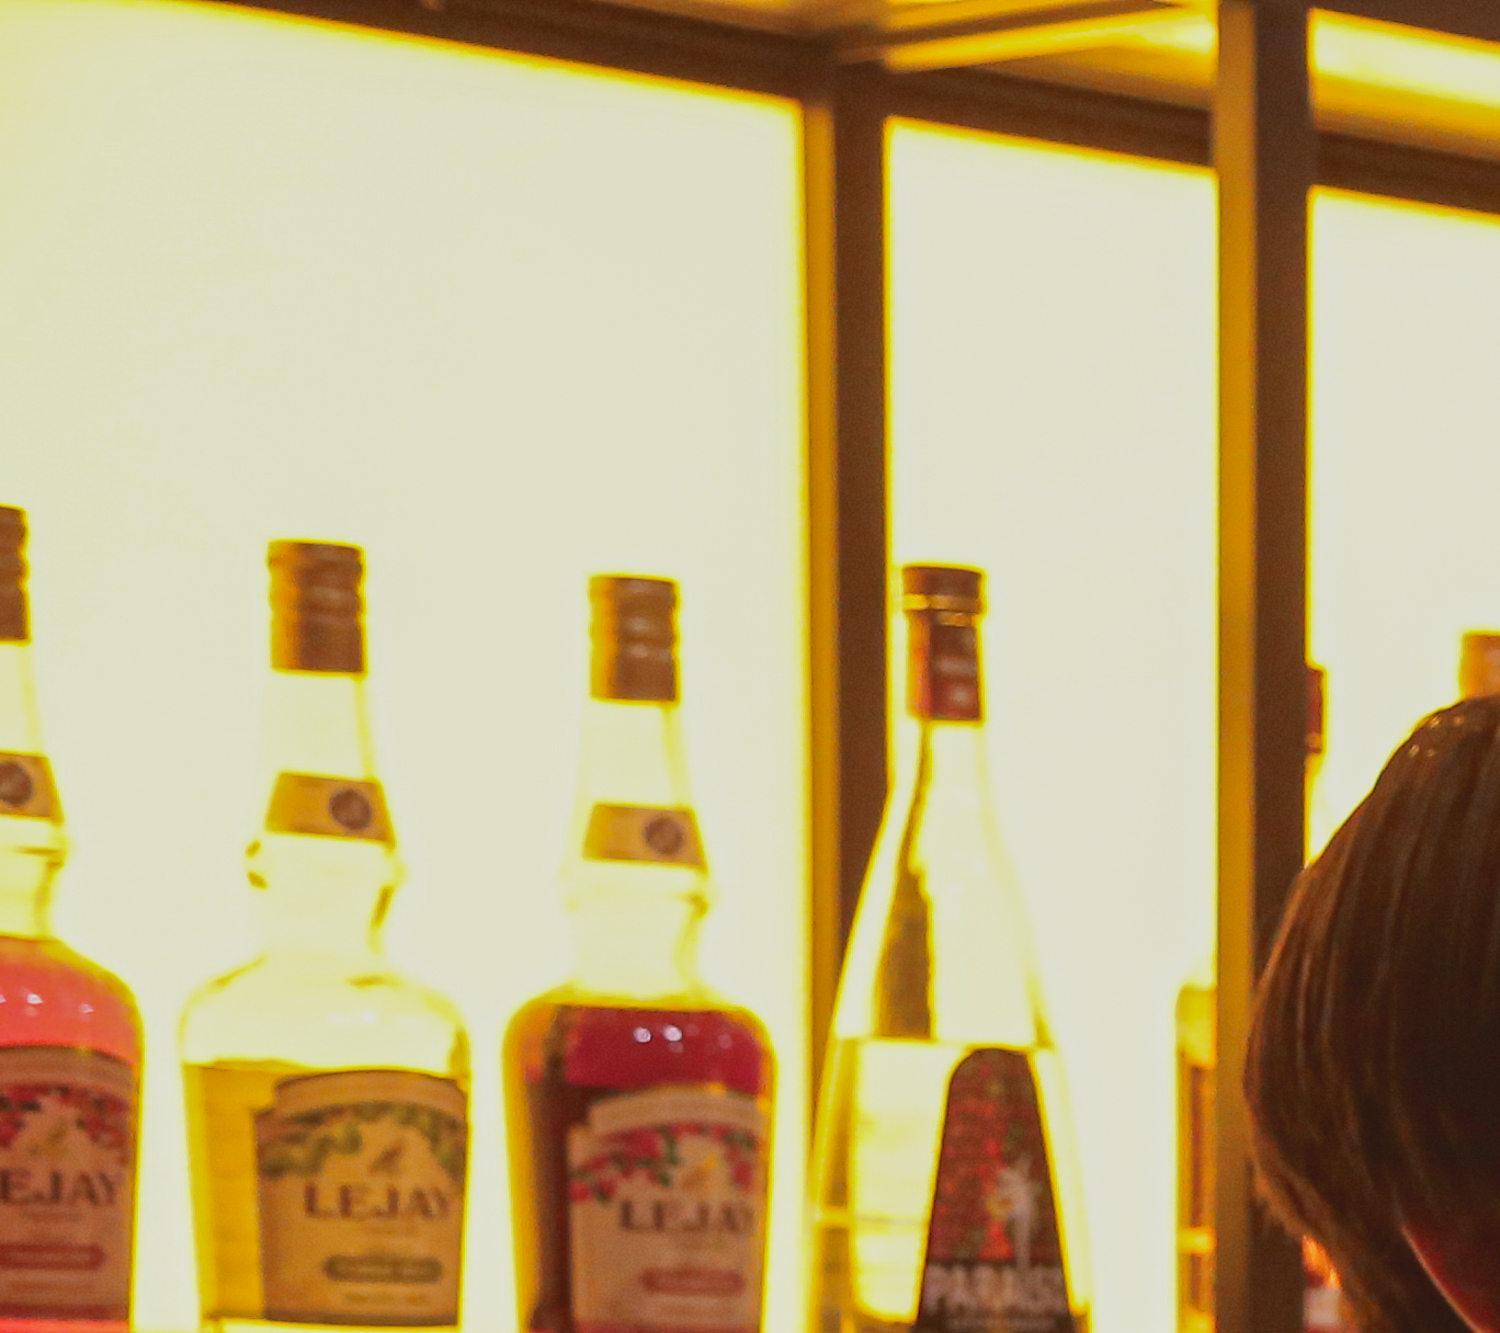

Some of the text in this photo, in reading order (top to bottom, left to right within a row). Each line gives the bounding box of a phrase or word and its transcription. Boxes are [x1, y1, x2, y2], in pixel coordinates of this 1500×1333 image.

[0, 1167, 115, 1206] EJAY
[304, 1184, 450, 1221] LEJAY
[620, 1199, 755, 1233] LEJAY
